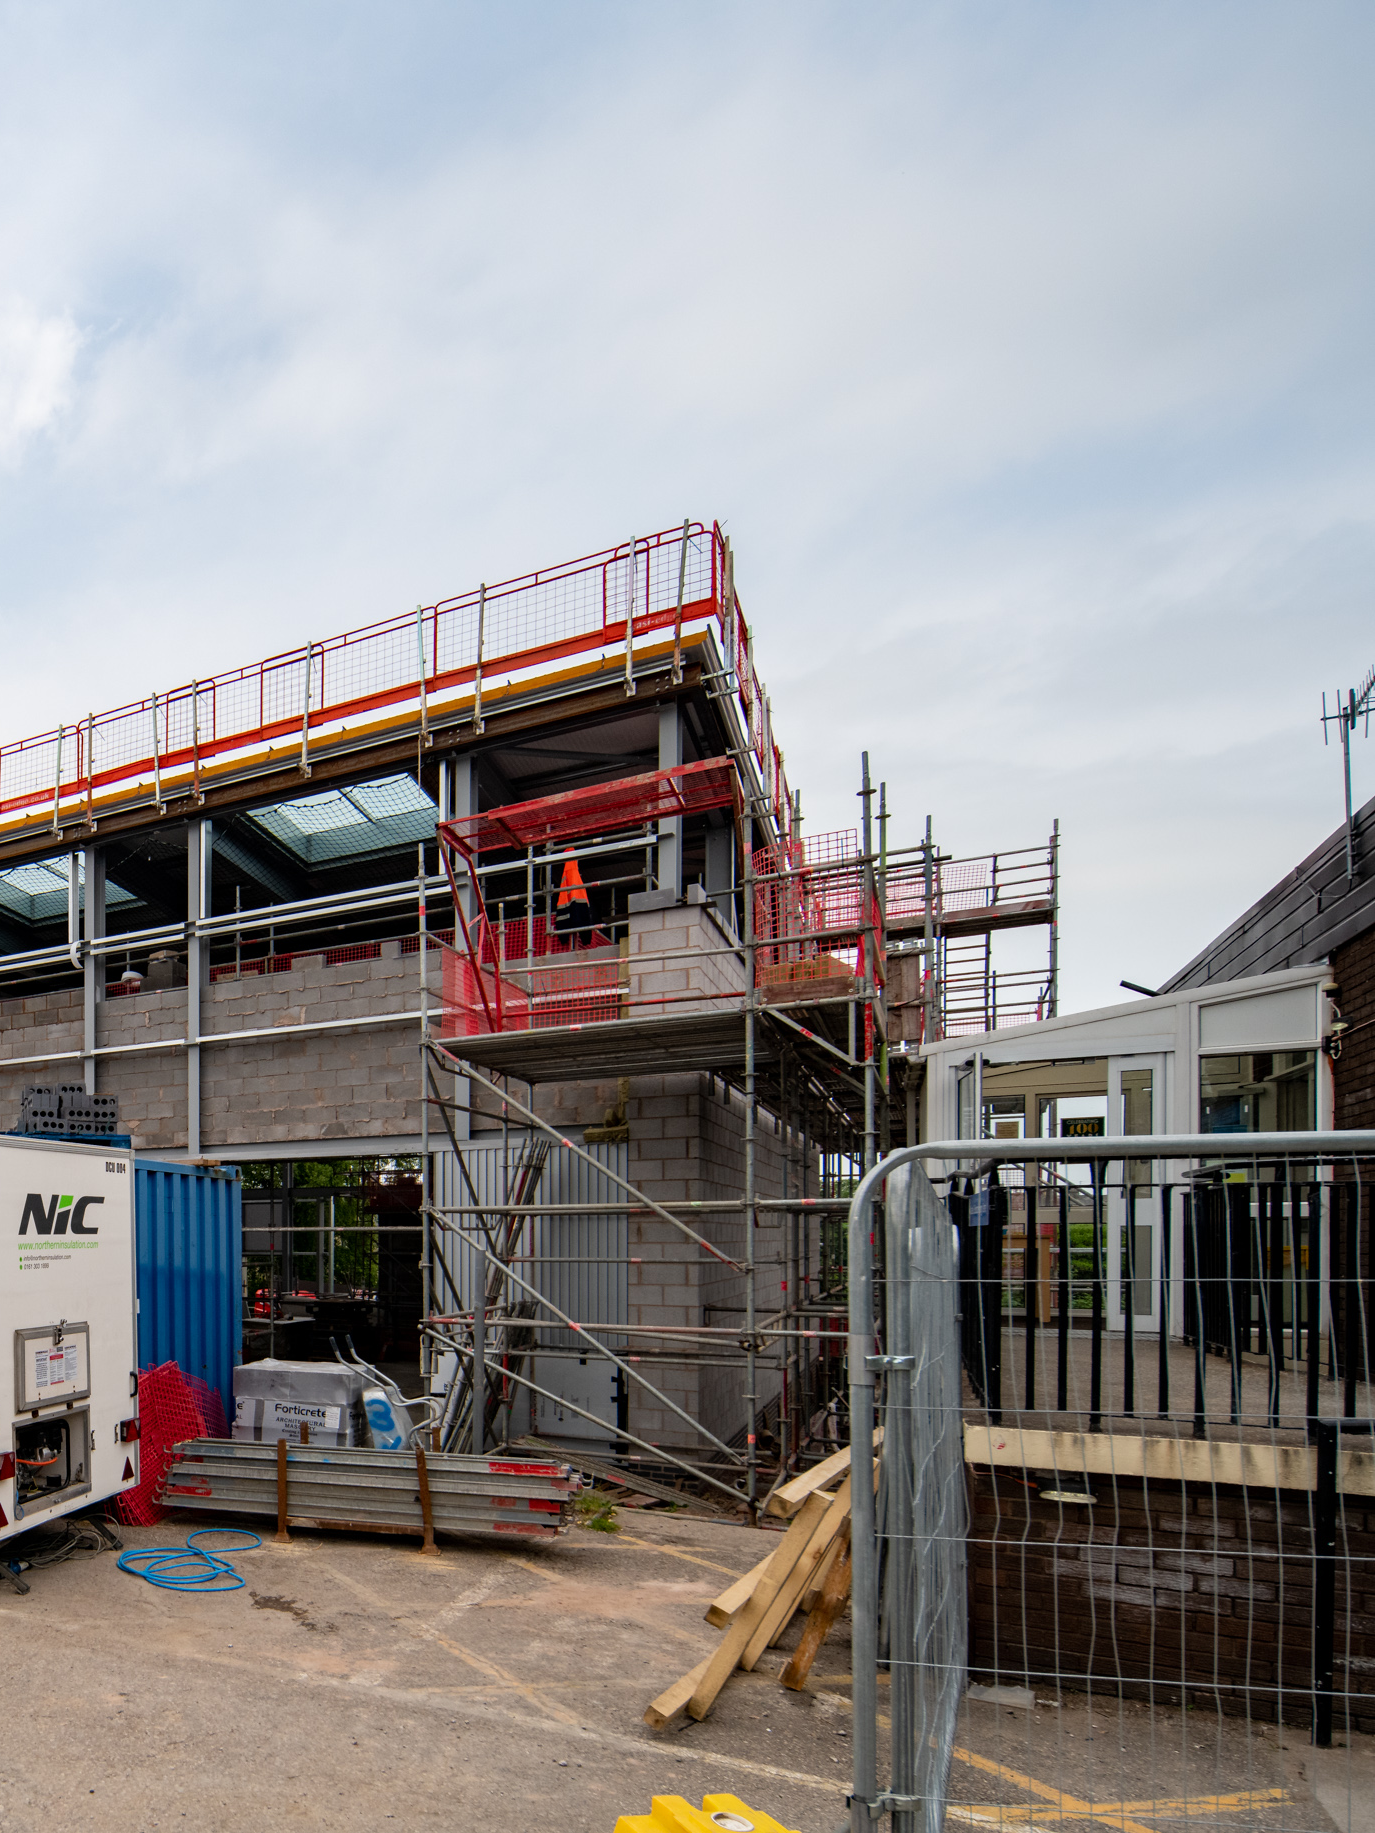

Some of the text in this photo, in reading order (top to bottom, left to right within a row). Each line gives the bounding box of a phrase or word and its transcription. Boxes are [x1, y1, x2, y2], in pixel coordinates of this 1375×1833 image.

[1069, 1123, 1099, 1135] 100
[105, 1161, 126, 1174] DCU 004
[17, 1240, 99, 1251] www.northerninsulation.com
[274, 1403, 327, 1418] Forticrete
[284, 1423, 316, 1432] MASRY
